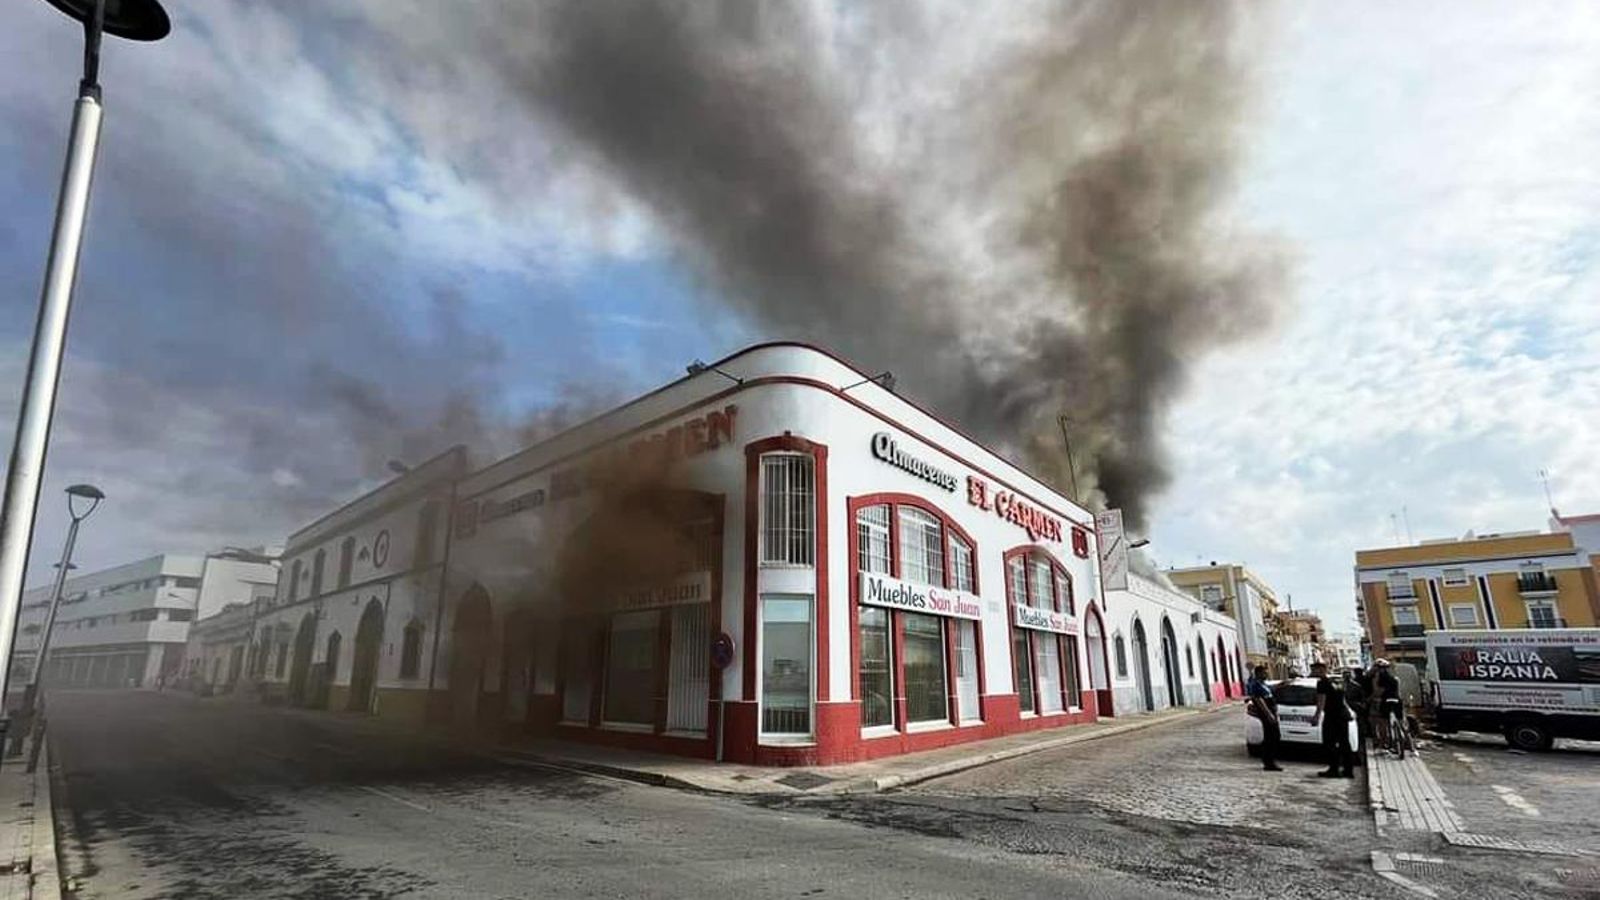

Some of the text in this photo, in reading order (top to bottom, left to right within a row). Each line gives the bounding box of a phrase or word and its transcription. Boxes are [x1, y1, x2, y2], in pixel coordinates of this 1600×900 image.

[966, 475, 992, 512] EL
[994, 491, 1062, 542] CARMEN
[868, 577, 980, 617] Muebles San Juan
[1019, 607, 1049, 628] Muebles
[1456, 665, 1558, 680] HISPANIA
